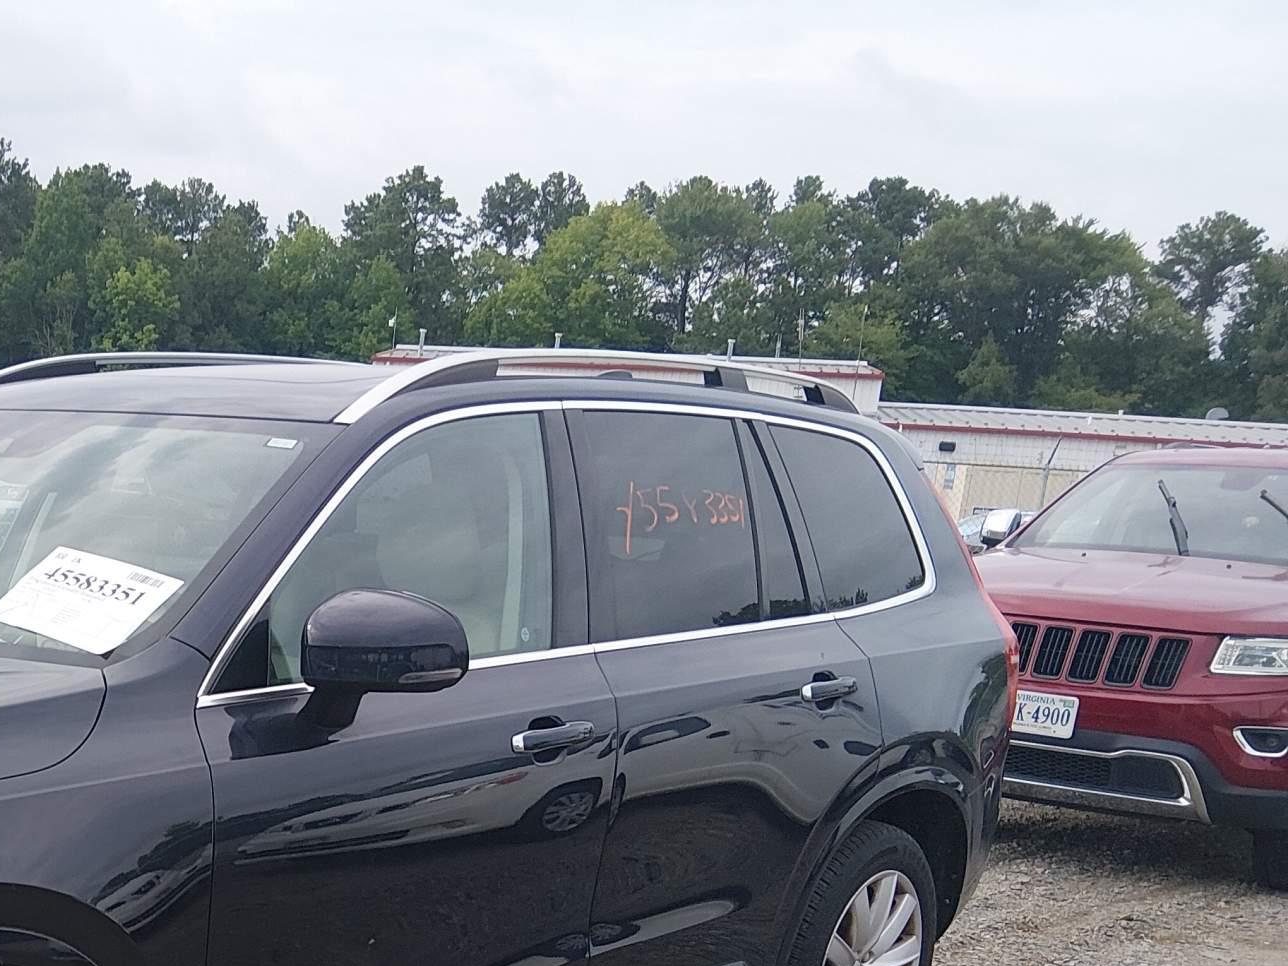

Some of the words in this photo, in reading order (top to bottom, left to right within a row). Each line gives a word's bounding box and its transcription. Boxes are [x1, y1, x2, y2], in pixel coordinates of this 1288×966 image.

[43, 567, 146, 605] 45583351
[1017, 693, 1056, 705] VIRGINIA
[1016, 702, 1071, 727] K-4900
